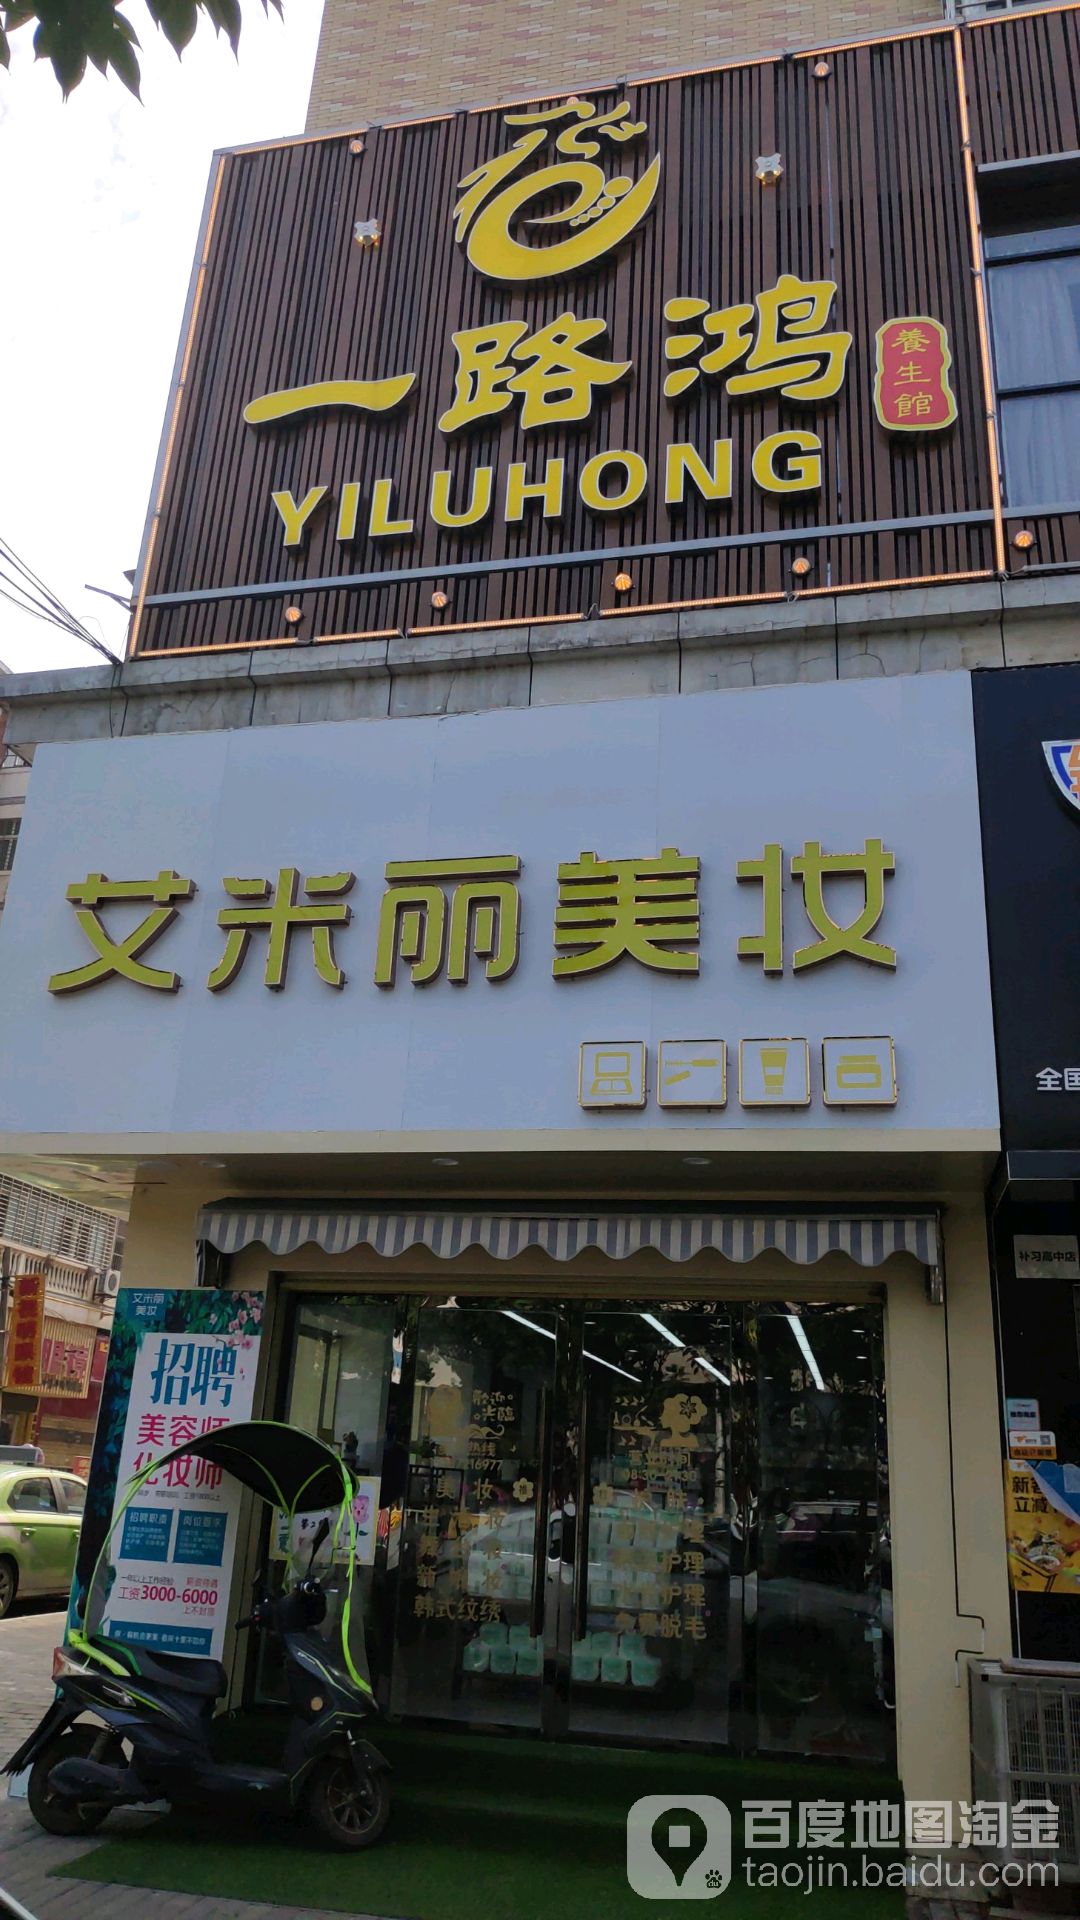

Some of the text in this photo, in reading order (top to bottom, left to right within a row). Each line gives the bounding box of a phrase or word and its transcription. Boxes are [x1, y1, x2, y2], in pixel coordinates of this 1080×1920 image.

[243, 274, 852, 433] 一路鸿
[891, 328, 933, 418] 養生館
[271, 430, 823, 547] YILUHONG
[47, 837, 897, 994] 艾米丽美妆
[1035, 1067, 1080, 1091] 全国
[150, 1338, 238, 1407] 招聘
[117, 1584, 218, 1606] 工资3000-6000
